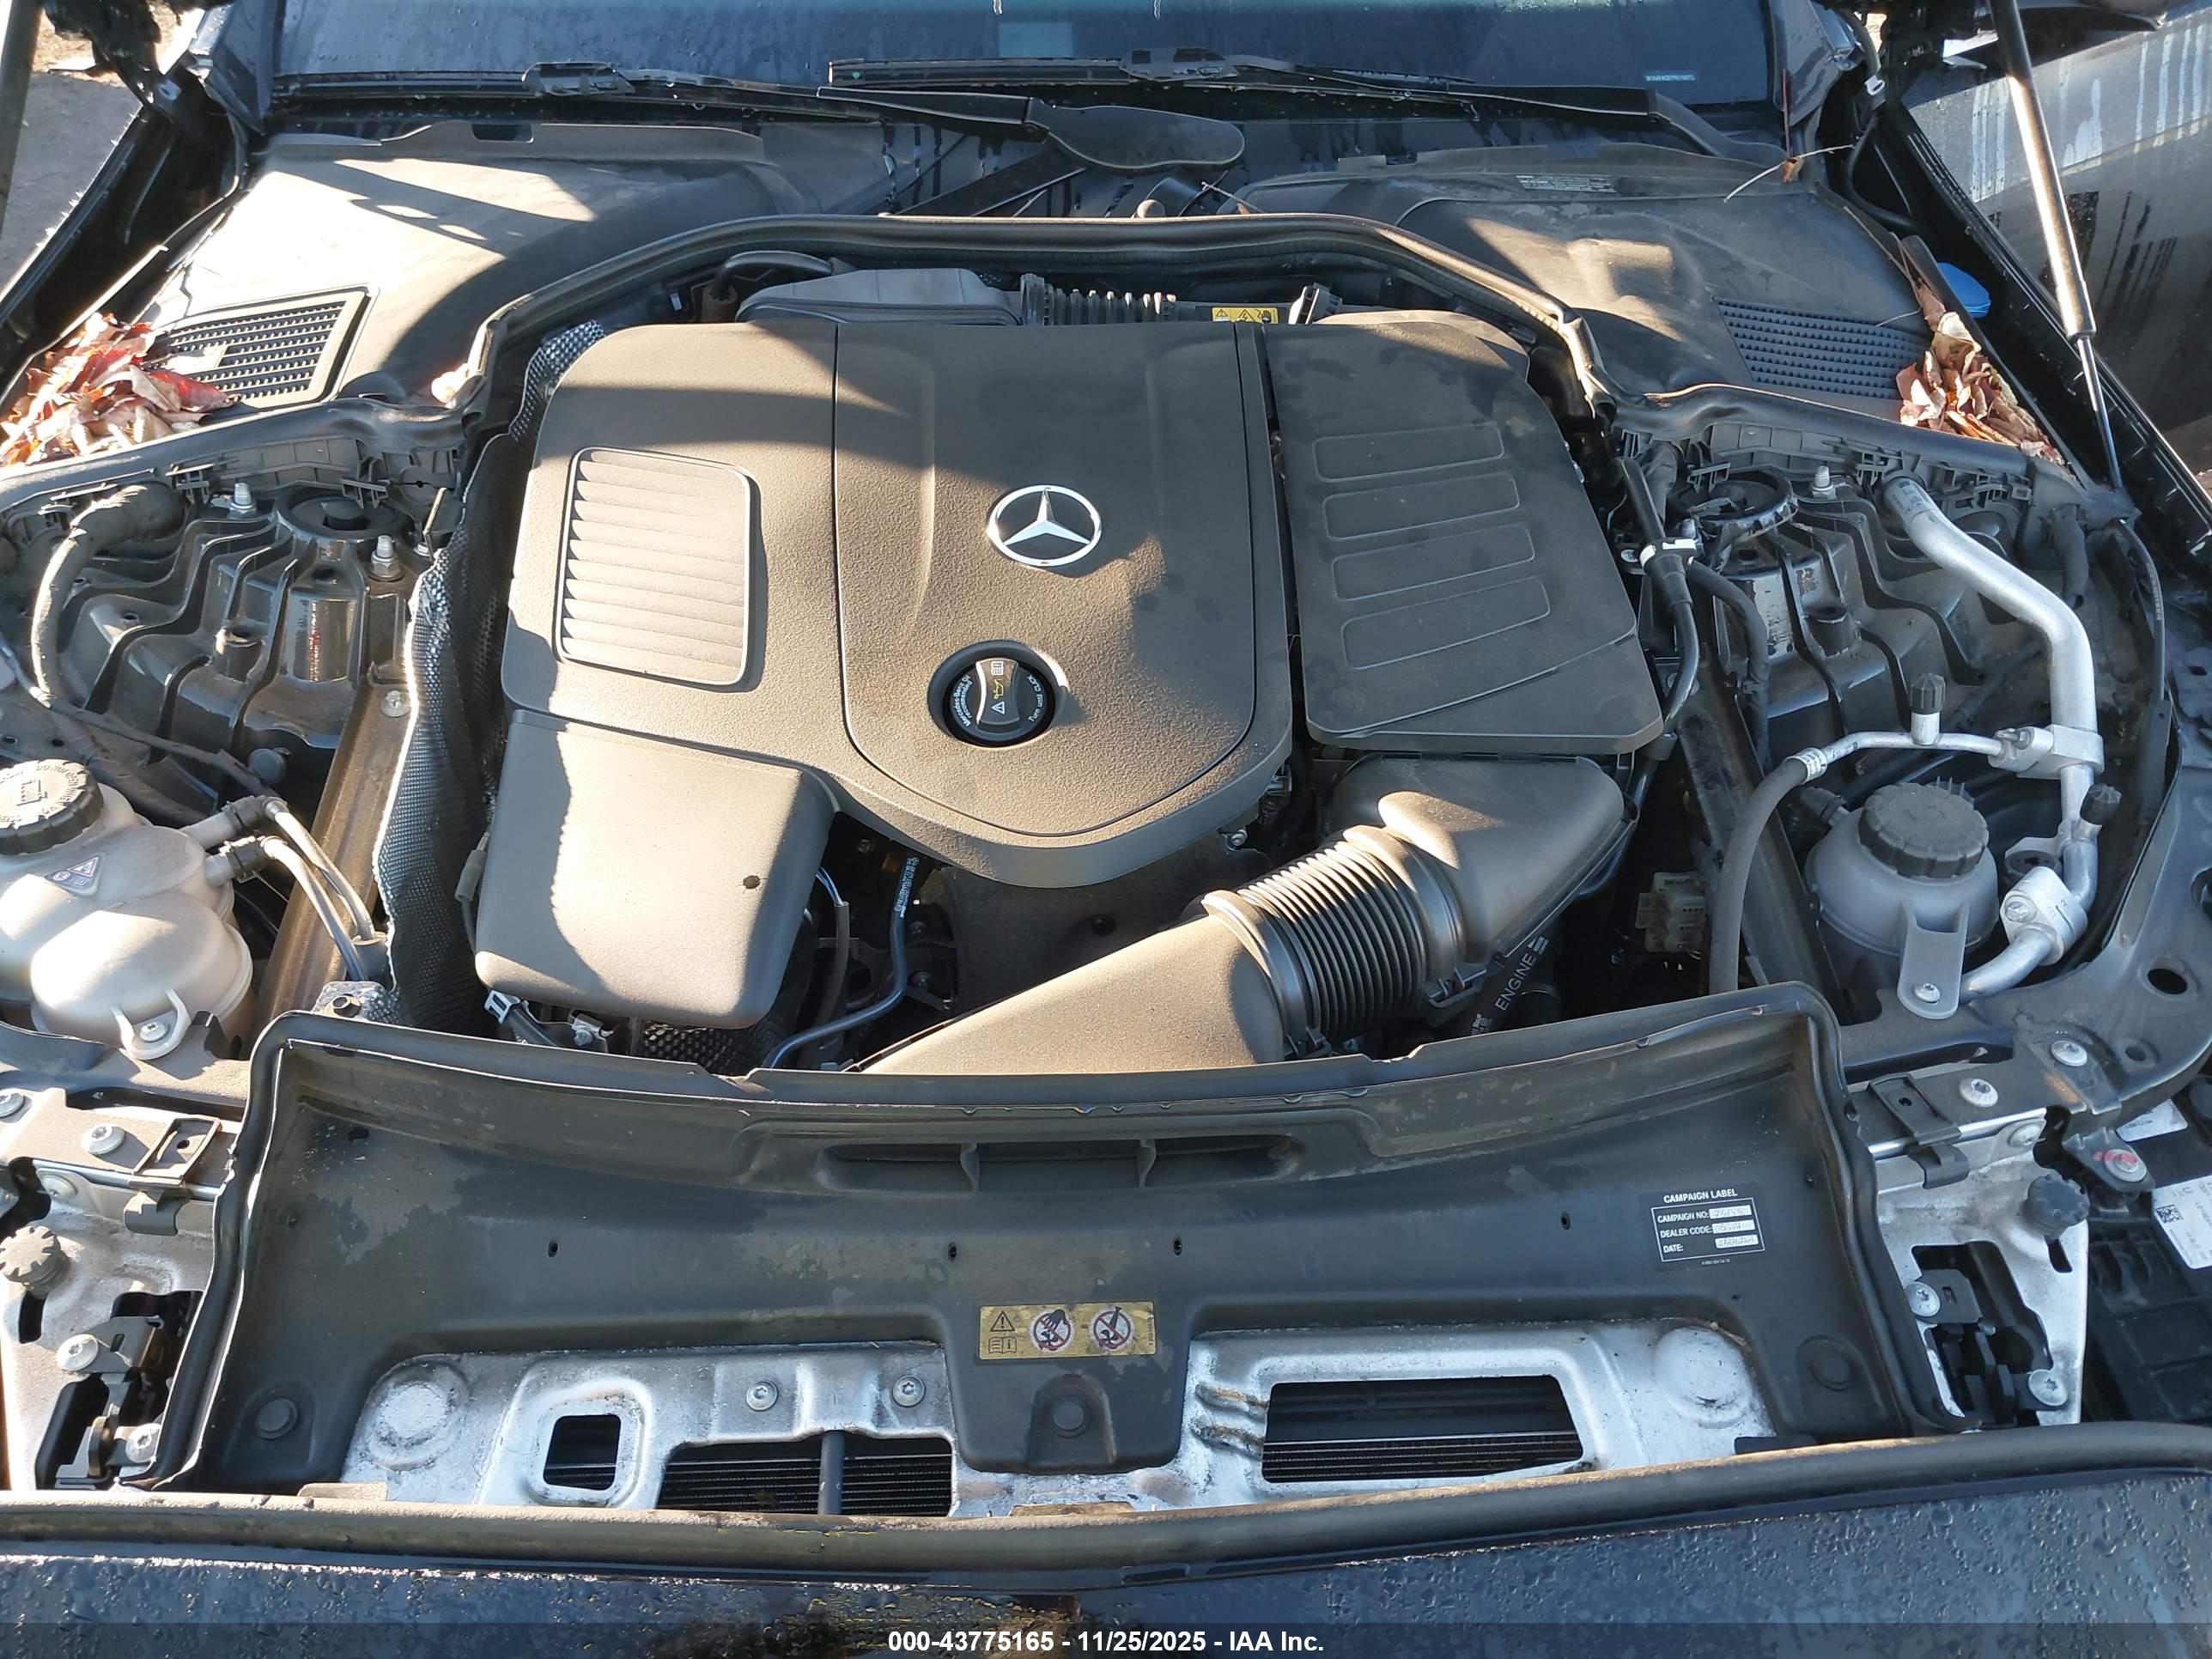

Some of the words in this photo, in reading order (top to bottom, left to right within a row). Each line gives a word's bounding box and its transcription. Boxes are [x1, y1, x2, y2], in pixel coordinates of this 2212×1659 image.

[1026, 674, 1042, 692] CLICK
[953, 683, 972, 726] Mercedes-Benz
[960, 680, 973, 719] recommended
[1028, 708, 1041, 722] Turn
[1494, 952, 1536, 1011] ENGINE
[1663, 1190, 1709, 1203] CAMPAIGN
[1711, 1188, 1738, 1199] LABEL
[1657, 1212, 1694, 1223] CAMPAIGN
[1696, 1211, 1709, 1219] NO:
[1660, 1227, 1688, 1238] DEALER
[1689, 1225, 1712, 1235] CODE:
[1663, 1243, 1684, 1253] DATE:
